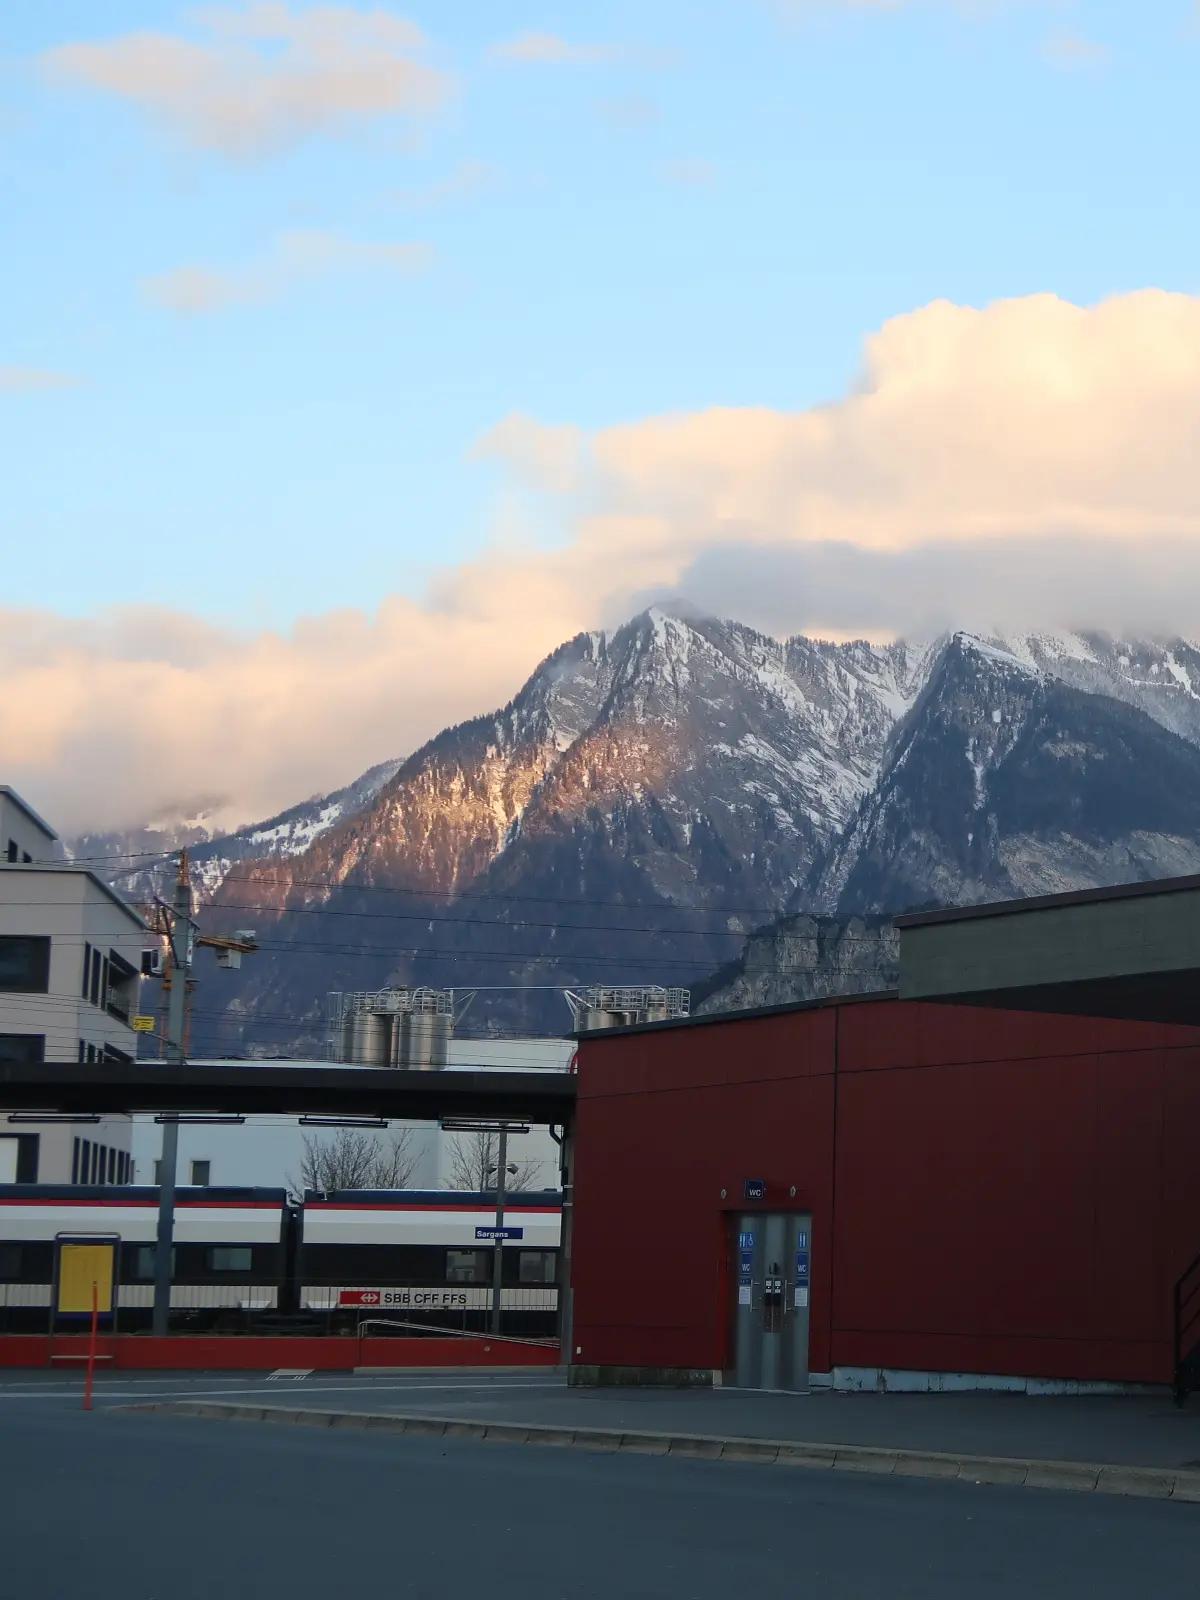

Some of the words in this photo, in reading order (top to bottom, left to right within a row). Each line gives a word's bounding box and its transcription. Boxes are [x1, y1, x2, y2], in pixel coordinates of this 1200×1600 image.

[749, 1189, 761, 1197] WC
[476, 1230, 509, 1239] Sargans
[384, 1293, 410, 1304] SBB
[414, 1293, 439, 1304] CFF
[442, 1293, 467, 1304] FFS
